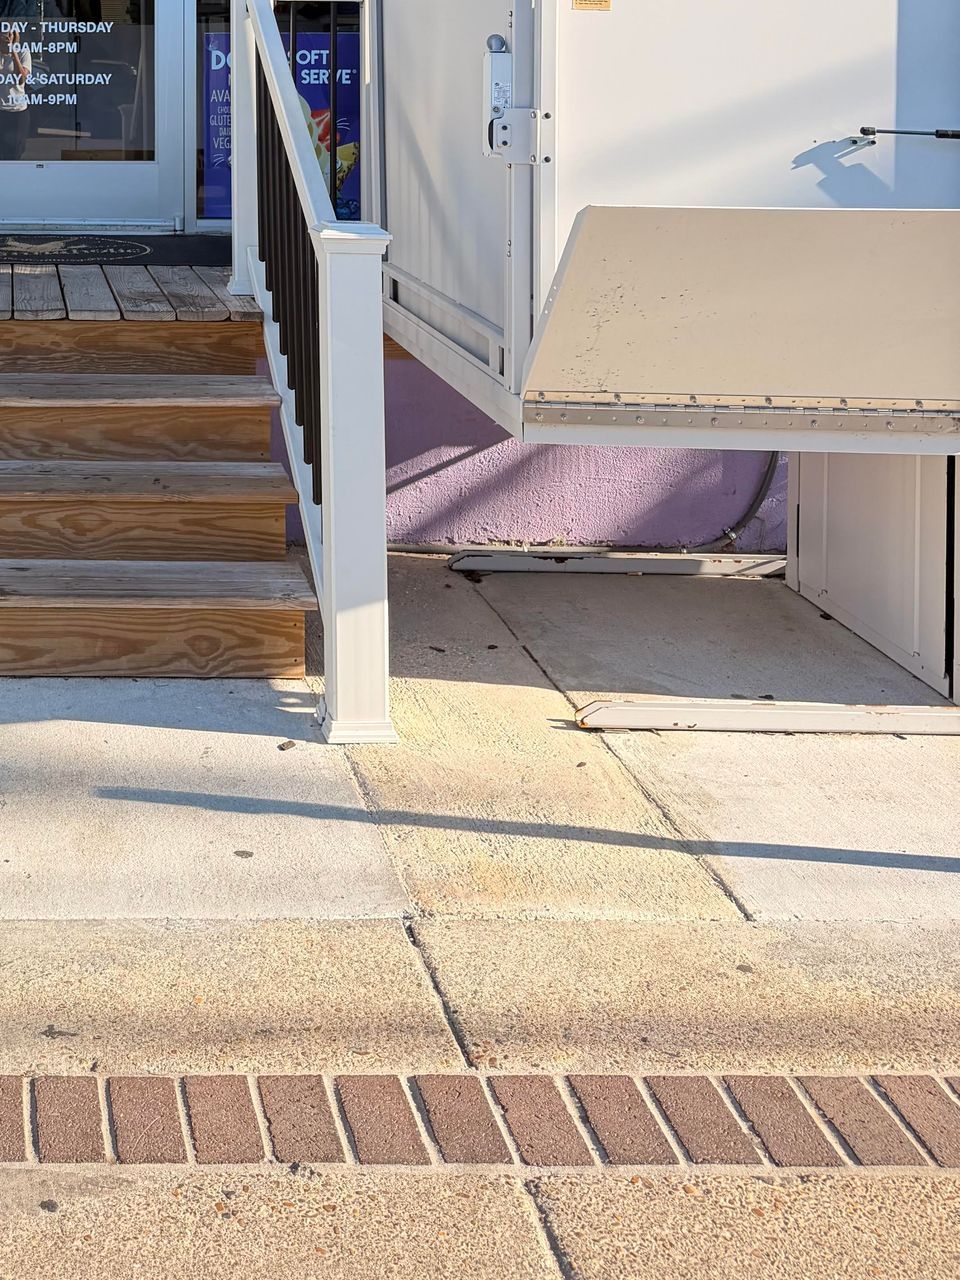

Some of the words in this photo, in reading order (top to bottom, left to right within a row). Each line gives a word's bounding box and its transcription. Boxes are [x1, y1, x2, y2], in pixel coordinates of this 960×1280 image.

[40, 21, 114, 33] THURSDAY
[7, 42, 77, 53] 10AM-8PM
[25, 73, 36, 85] &
[39, 73, 112, 85] SATURDAY
